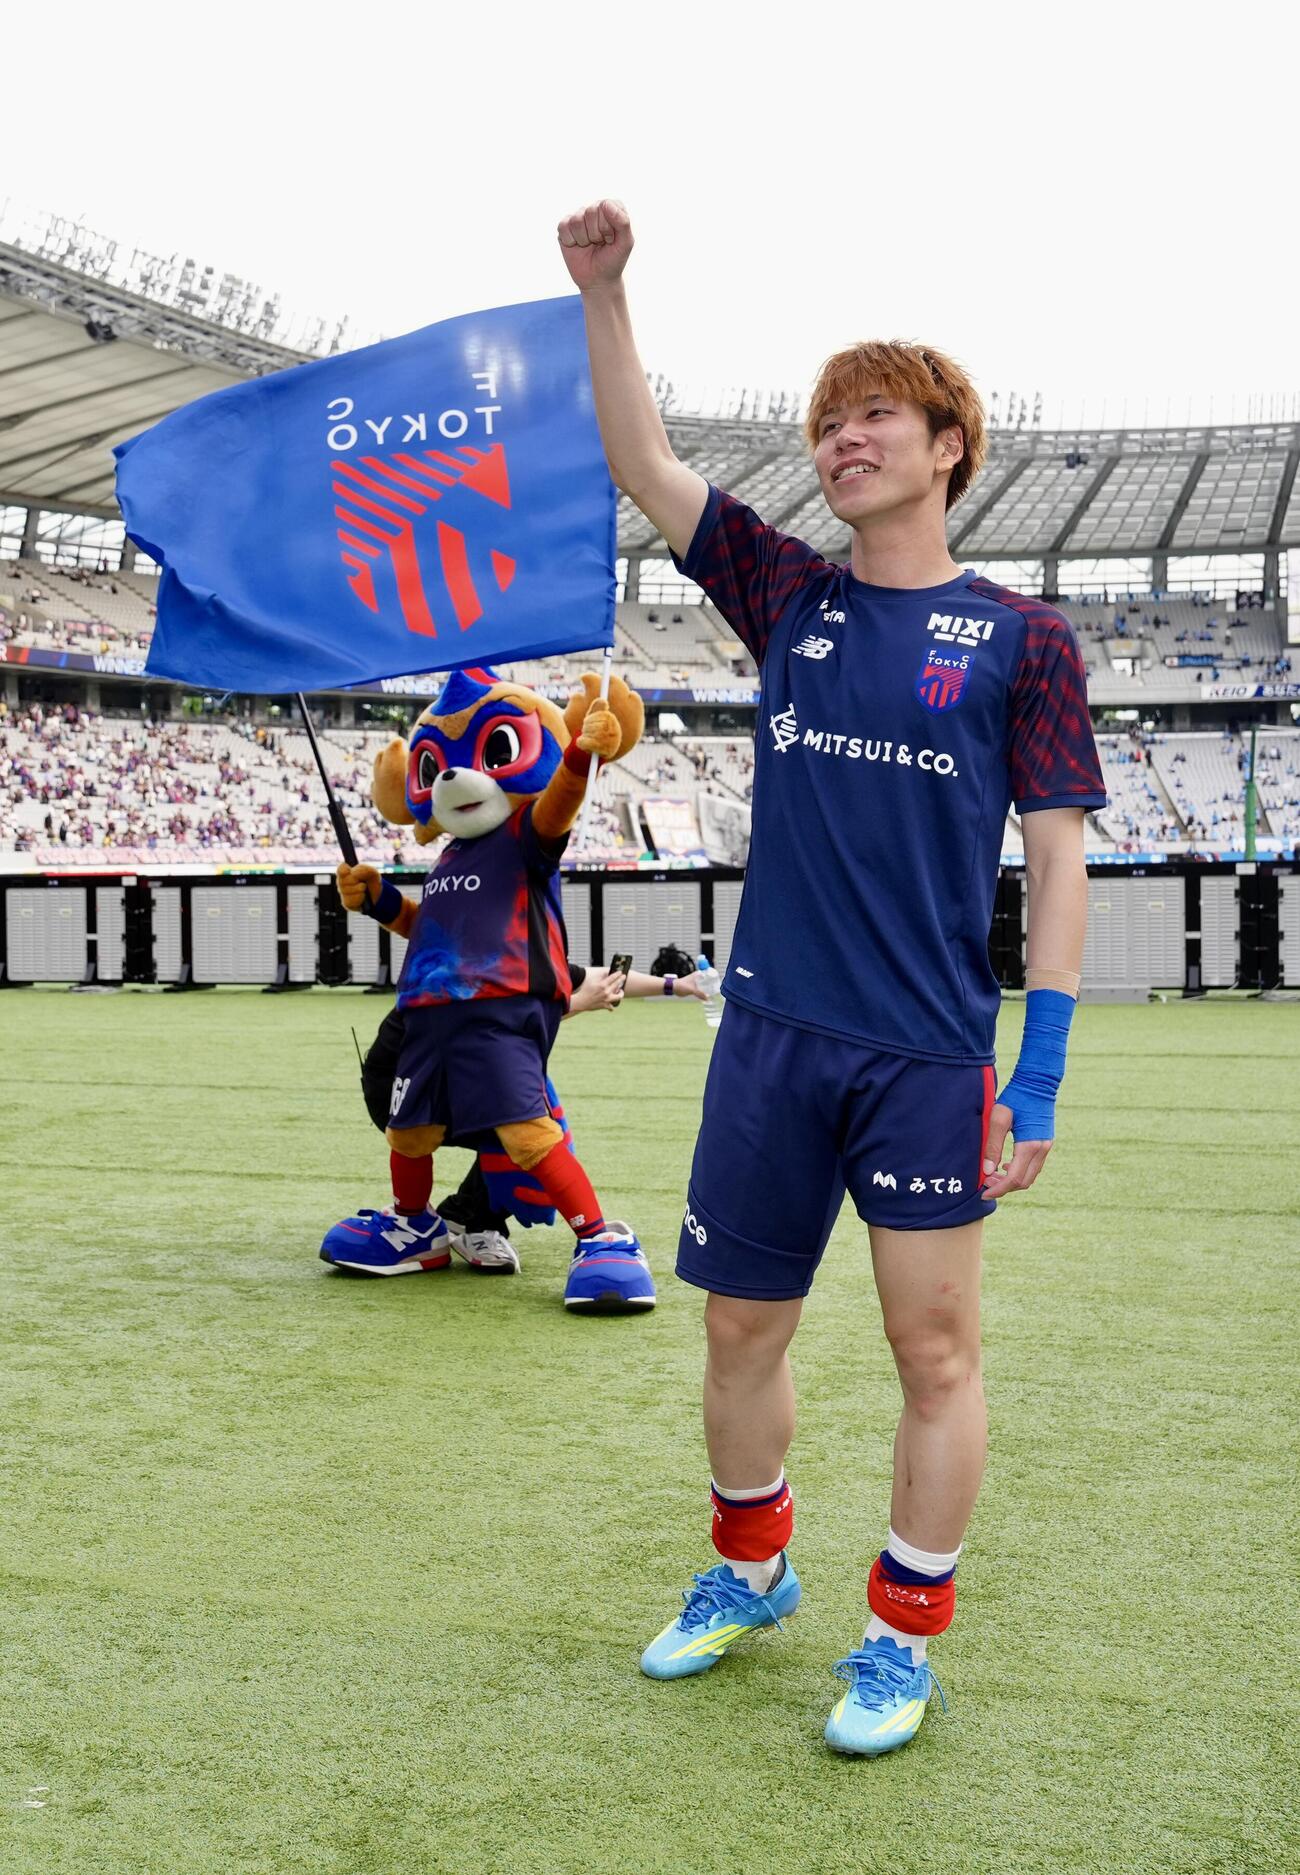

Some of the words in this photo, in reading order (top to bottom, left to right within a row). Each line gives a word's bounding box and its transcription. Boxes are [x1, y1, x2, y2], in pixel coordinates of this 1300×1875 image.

[927, 612, 995, 641] MIXI
[928, 656, 968, 669] TOKYO
[692, 688, 754, 703] WINNER
[424, 875, 481, 898] TOKYO
[909, 1177, 963, 1194] みてね
